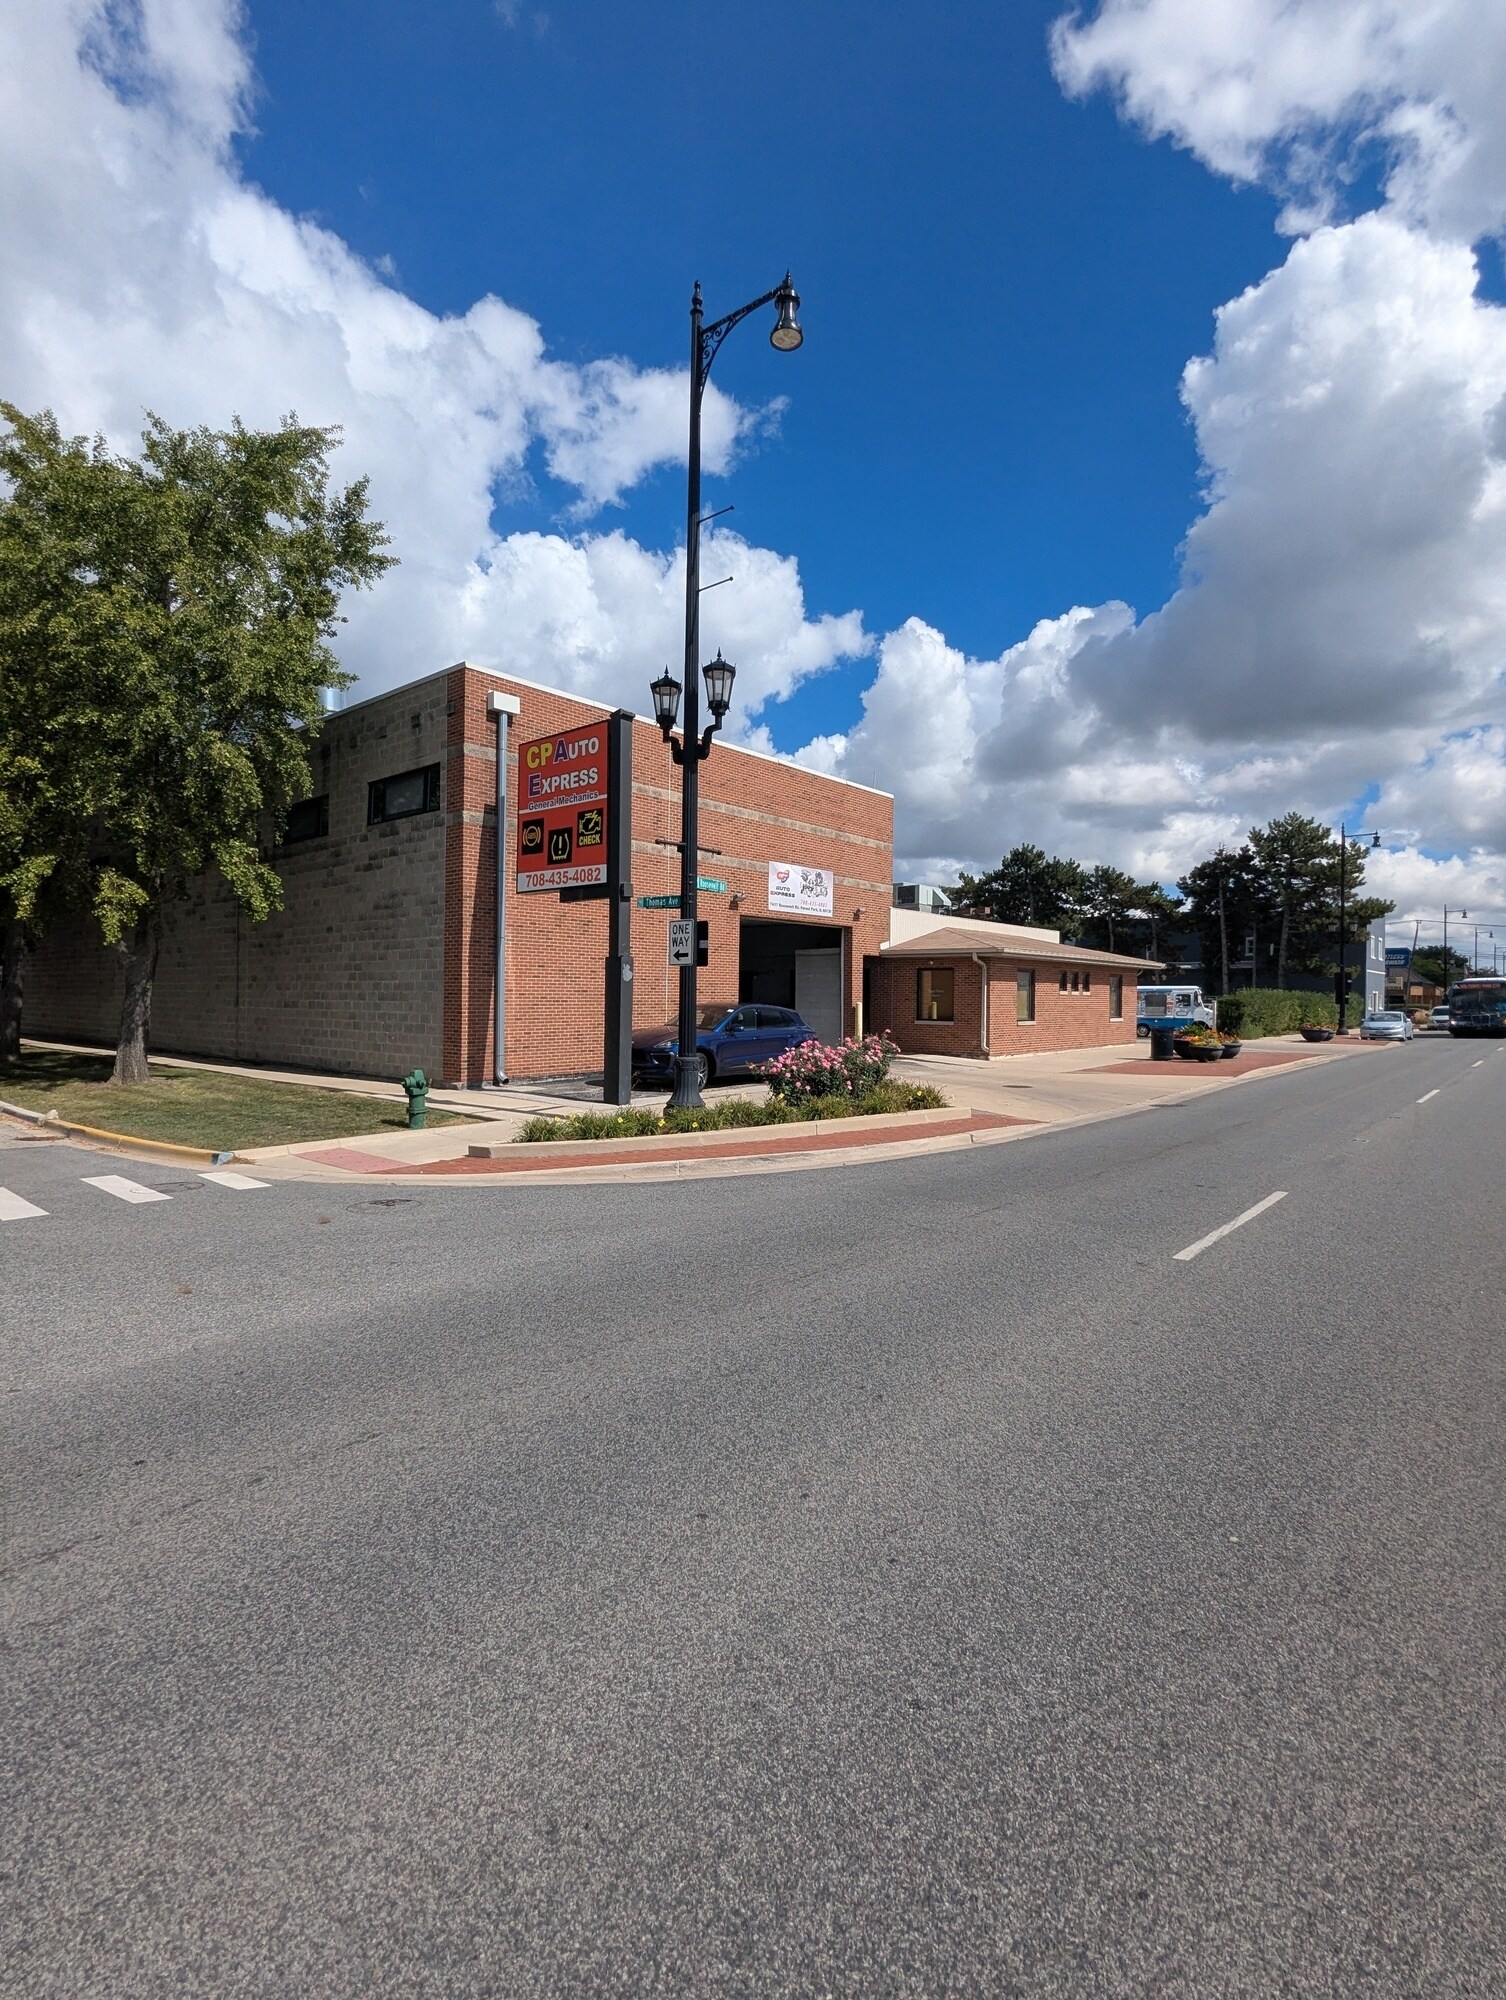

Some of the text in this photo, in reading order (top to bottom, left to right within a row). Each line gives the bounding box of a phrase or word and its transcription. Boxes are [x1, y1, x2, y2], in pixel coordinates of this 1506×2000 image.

[528, 790, 599, 811] General Mechanics
[579, 833, 601, 846] CHECK
[526, 867, 601, 888] 708-435-4082
[646, 896, 679, 906] Thomas Ave
[672, 923, 690, 935] ONE
[672, 937, 690, 948] WAY
